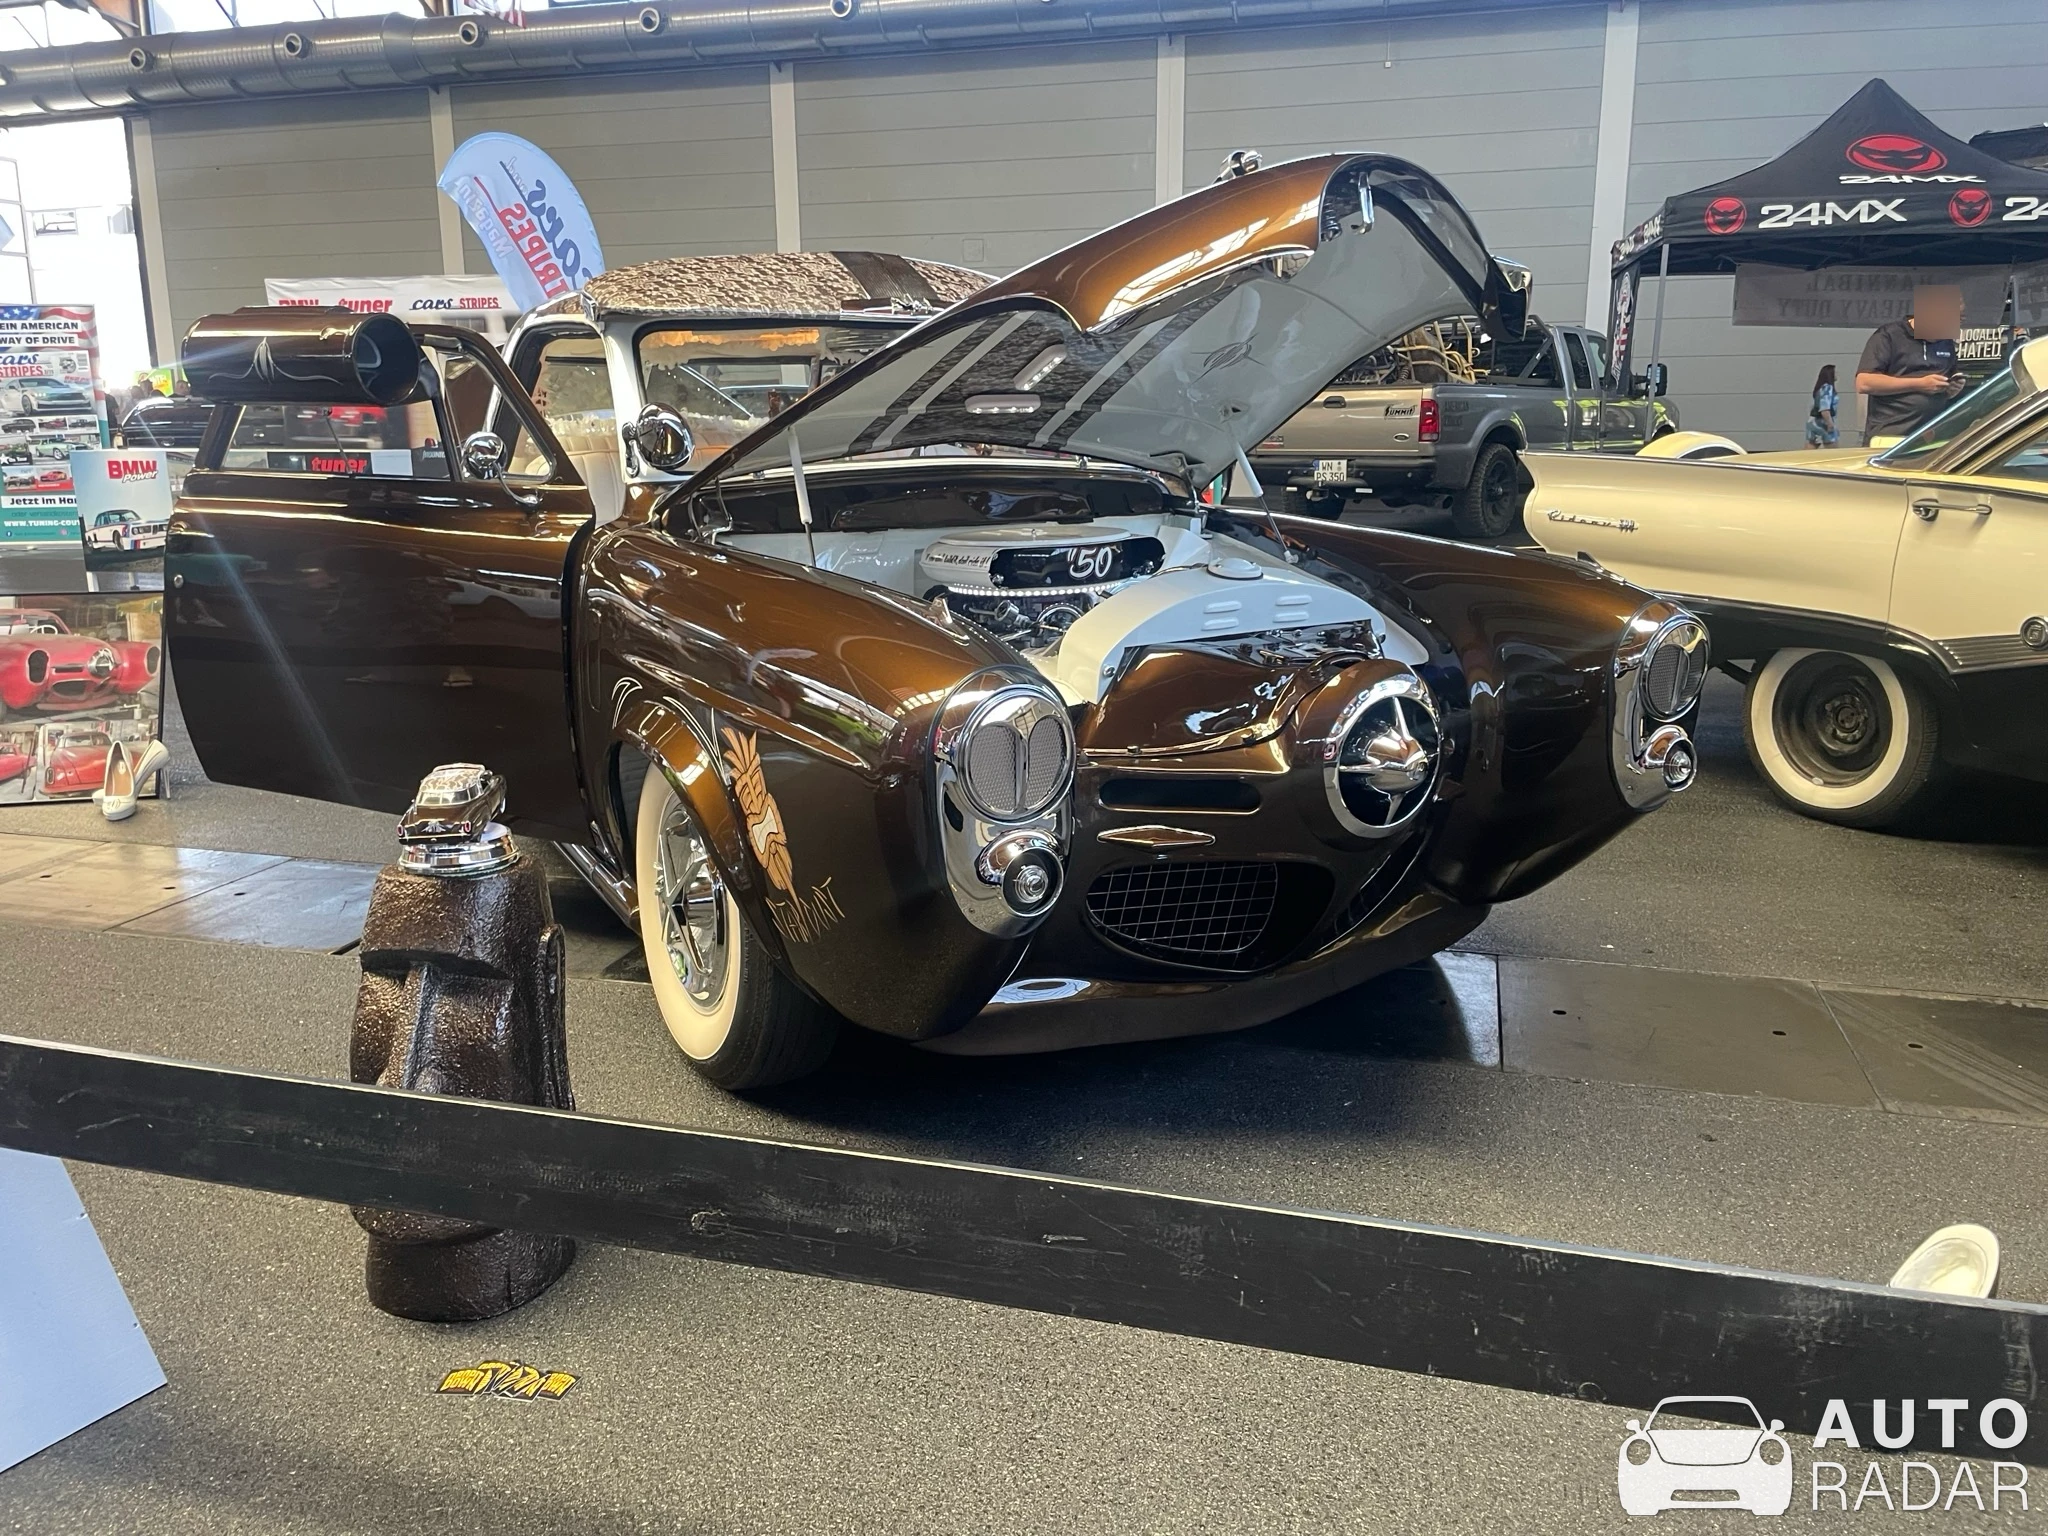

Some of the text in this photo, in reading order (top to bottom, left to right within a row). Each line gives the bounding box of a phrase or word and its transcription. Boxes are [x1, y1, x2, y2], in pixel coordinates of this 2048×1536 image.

[1839, 175, 1987, 185] 24MX
[1758, 198, 1907, 228] 24MX
[412, 298, 453, 310] cars
[460, 297, 499, 309] STRIPES
[21, 322, 78, 330] AMERICAN
[42, 336, 75, 344] DRIVE
[311, 457, 367, 473] tuner
[1322, 462, 1333, 471] WN
[108, 461, 157, 480] BMW
[123, 470, 157, 483] Power
[1316, 471, 1345, 481] PS 350
[10, 497, 39, 505] Jetzt
[42, 497, 56, 505] im
